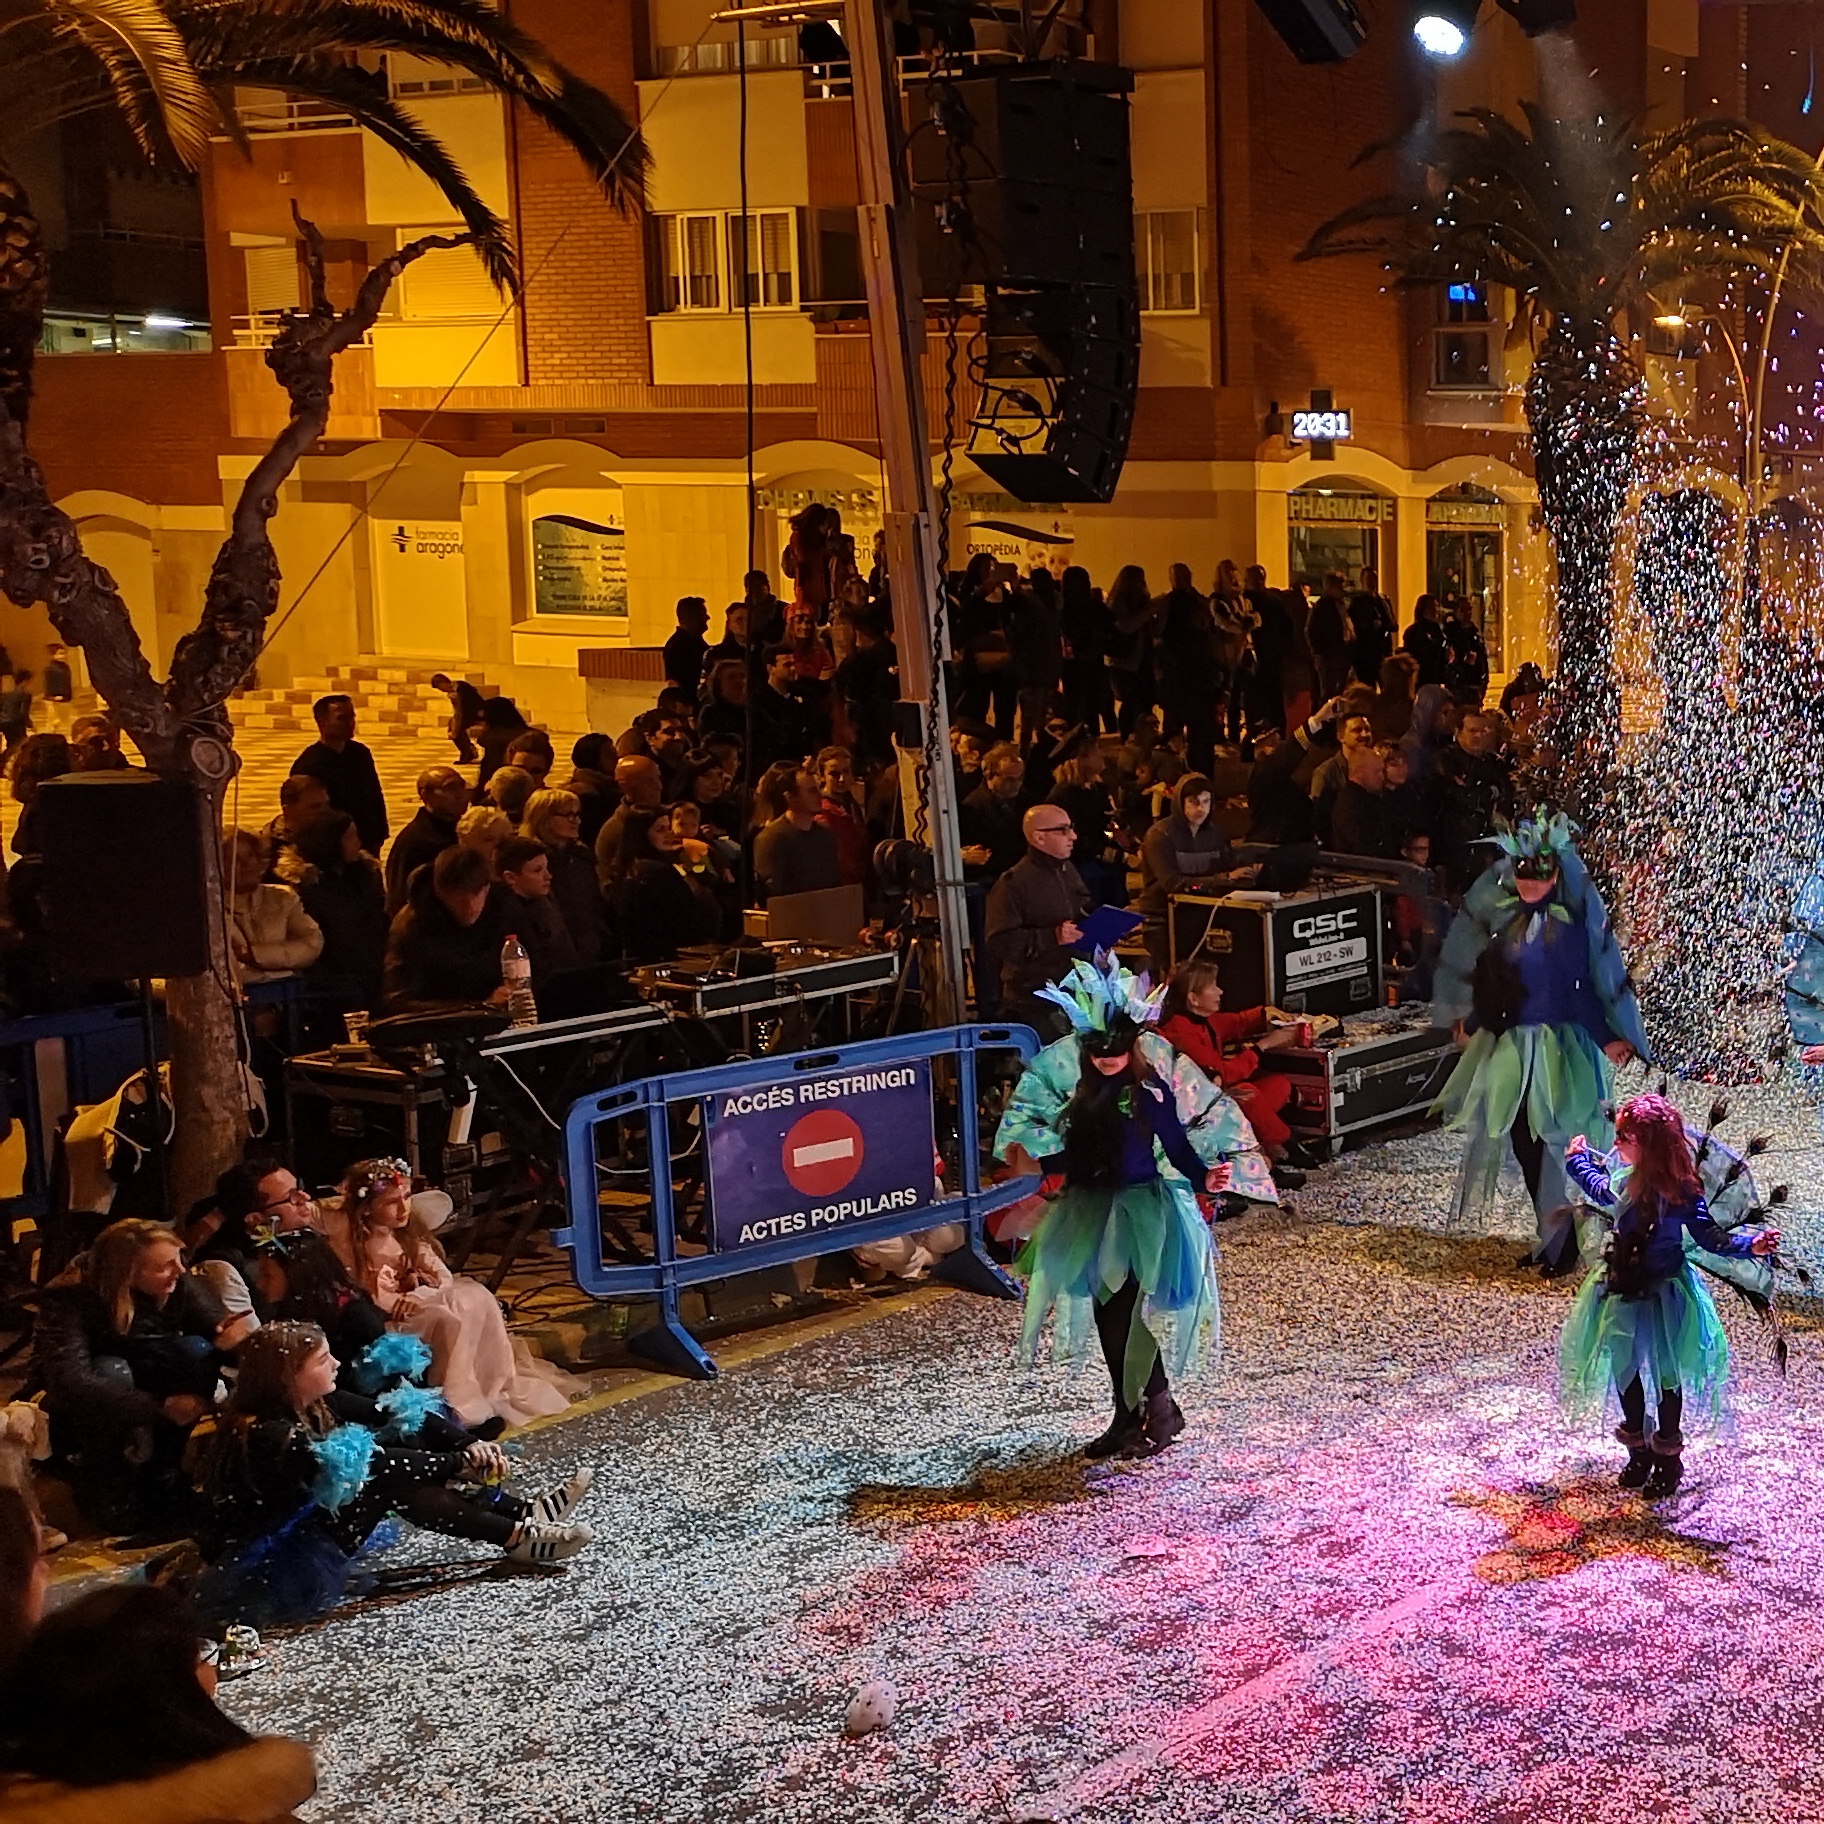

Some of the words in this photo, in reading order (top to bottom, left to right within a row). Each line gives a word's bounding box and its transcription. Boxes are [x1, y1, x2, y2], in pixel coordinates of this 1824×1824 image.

[1289, 496, 1394, 521] PHARMACIE
[415, 526, 459, 541] farmacia
[1293, 907, 1358, 939] QSC
[1298, 954, 1315, 967] WL
[1339, 945, 1354, 959] SW
[722, 1085, 795, 1118] ACCÉS
[738, 1212, 807, 1244] ACTES
[811, 1188, 918, 1228] POPULARS
